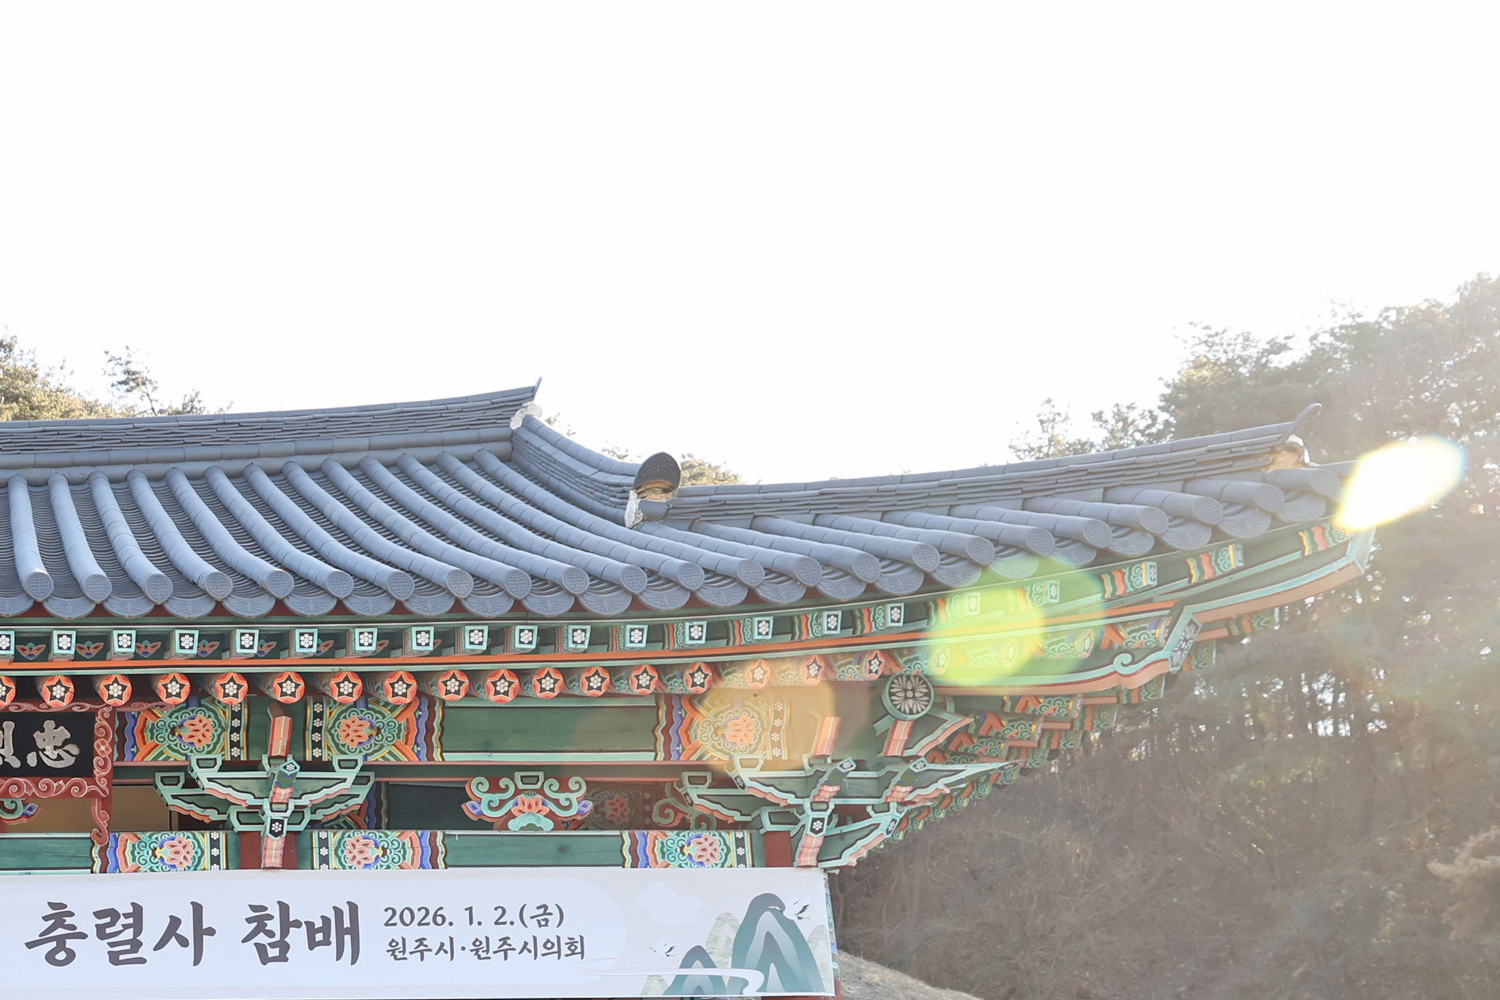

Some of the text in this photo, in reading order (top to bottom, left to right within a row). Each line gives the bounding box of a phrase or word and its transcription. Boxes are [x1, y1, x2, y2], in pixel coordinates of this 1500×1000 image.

[383, 903, 565, 929] 2026. 1. 2.(금)
[24, 900, 217, 967] 충렬사
[240, 900, 361, 966] 참배
[385, 934, 586, 962] 원주시·원주시의회
